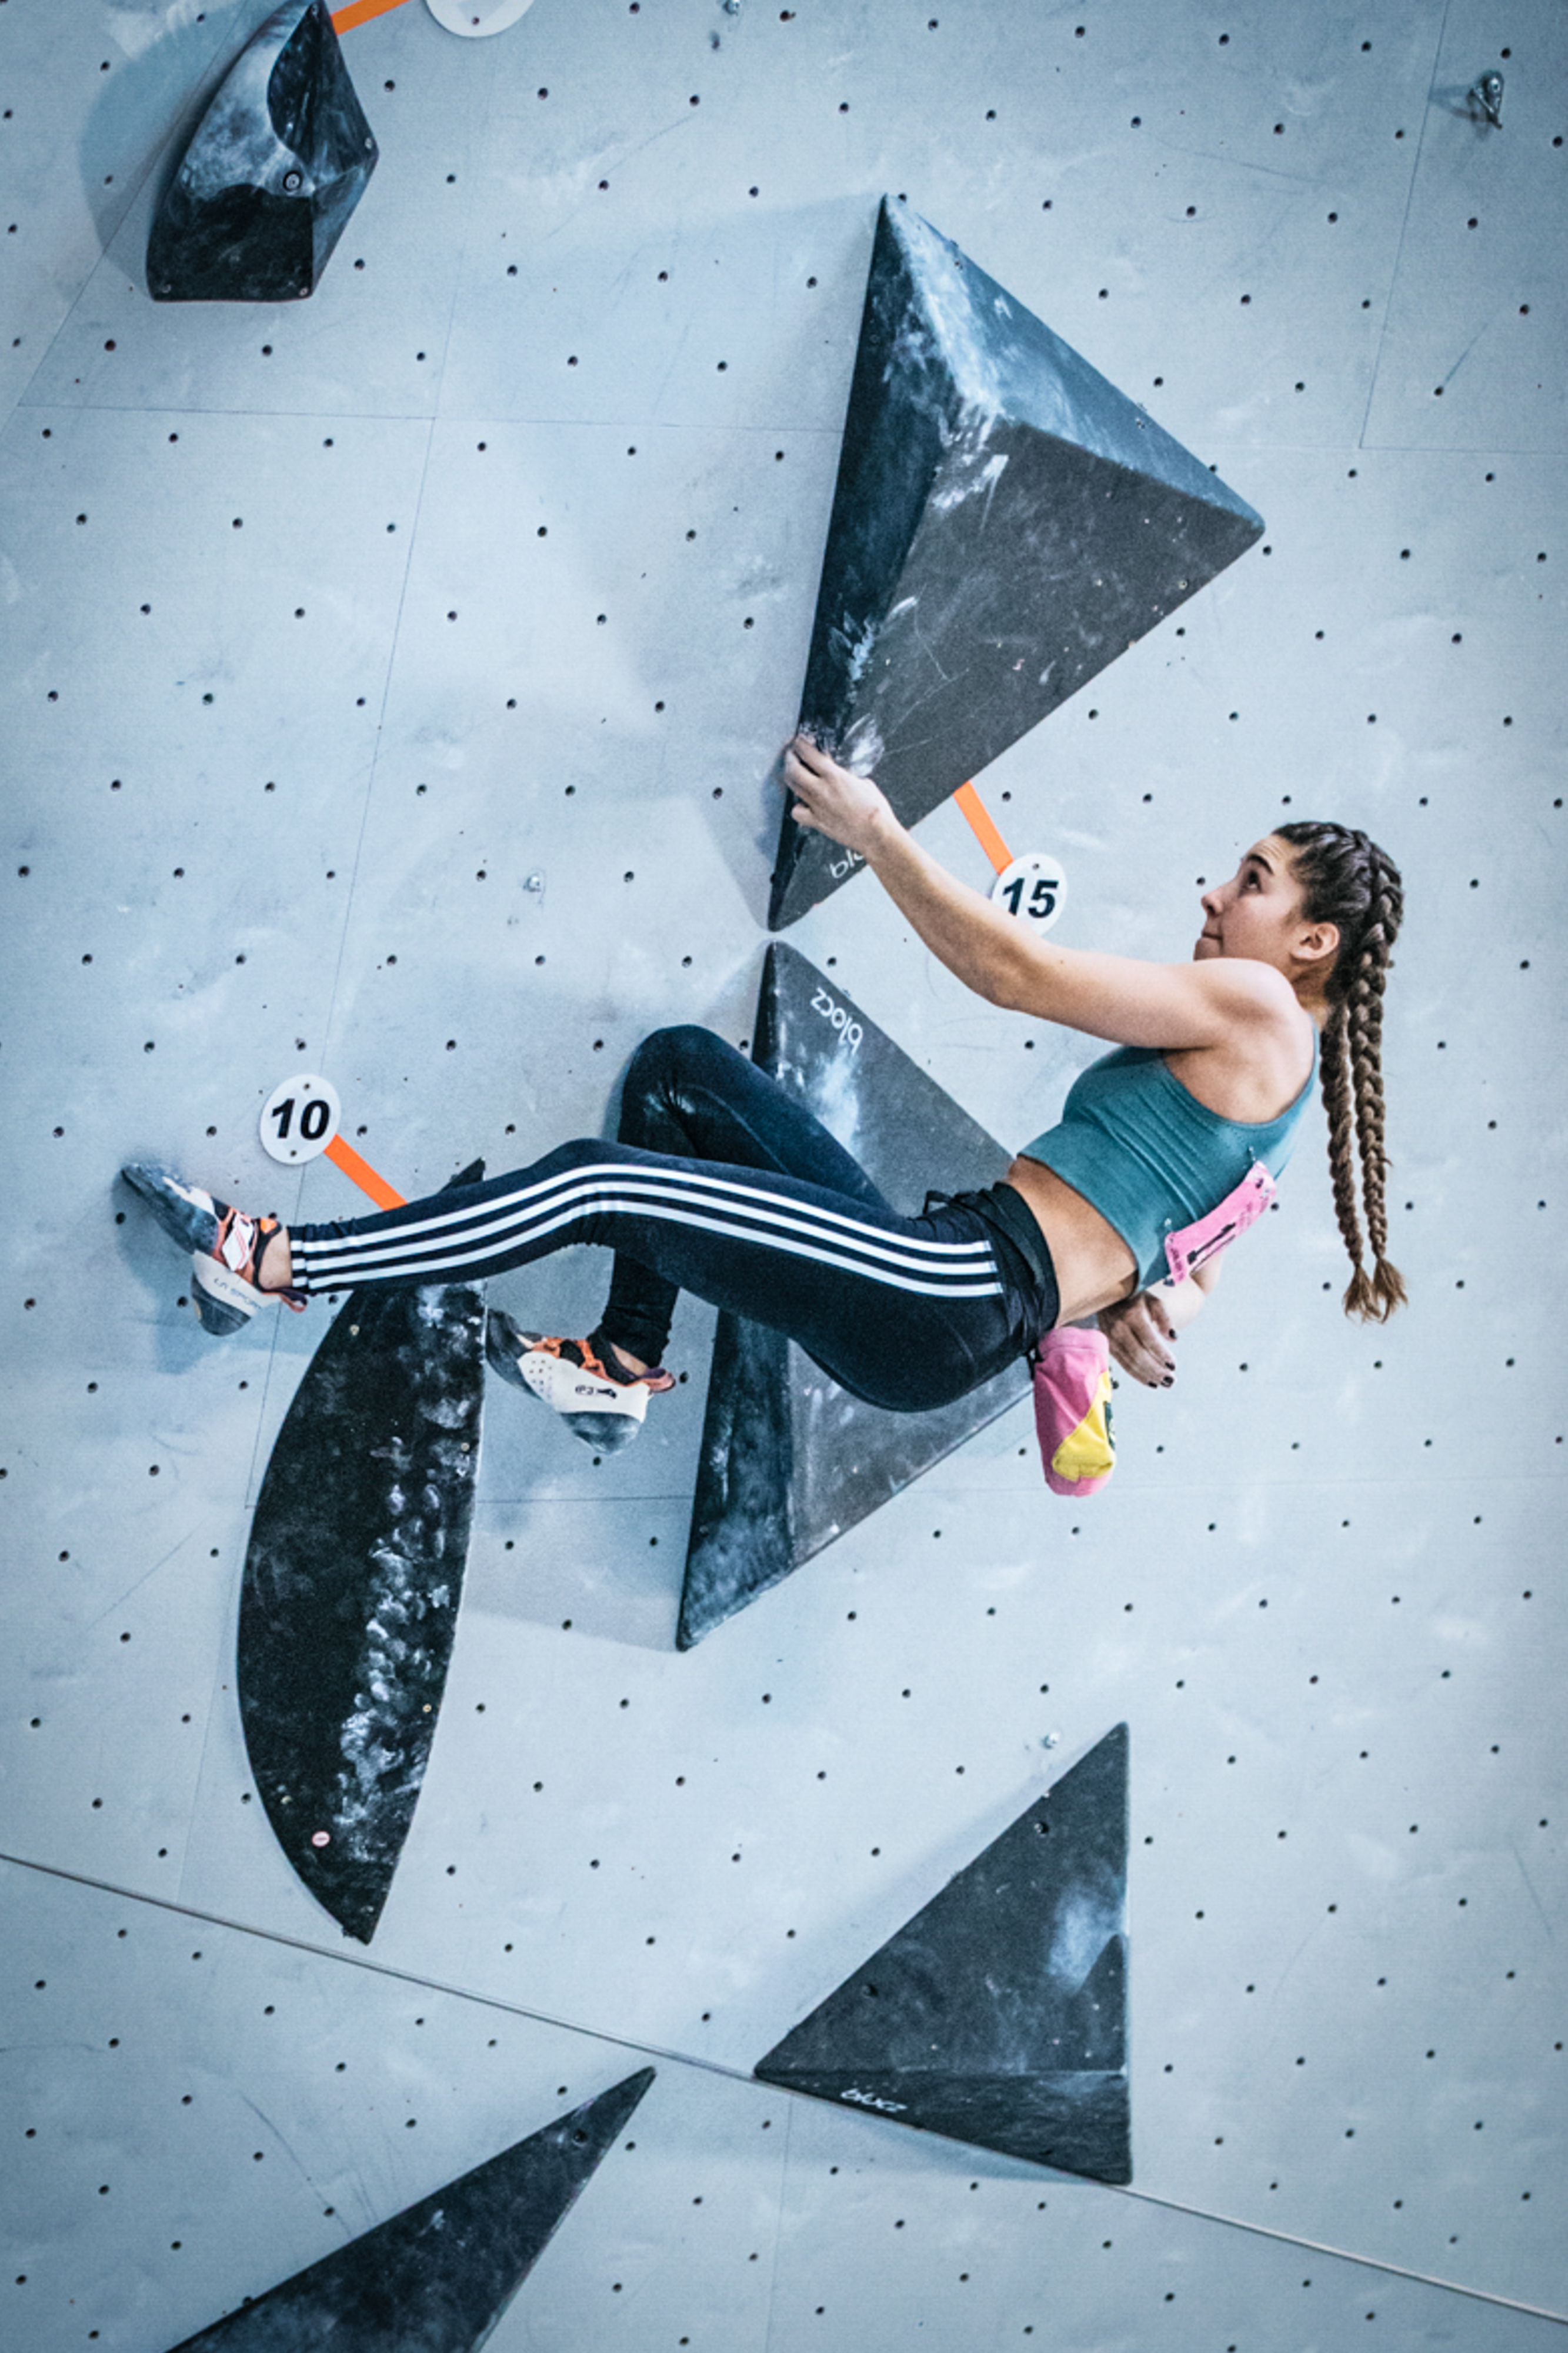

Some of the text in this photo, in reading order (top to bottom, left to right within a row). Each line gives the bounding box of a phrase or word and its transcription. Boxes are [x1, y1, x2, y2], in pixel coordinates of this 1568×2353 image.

[1002, 877, 1059, 919] 15
[810, 986, 863, 1056] blocz
[271, 1098, 331, 1141] 10
